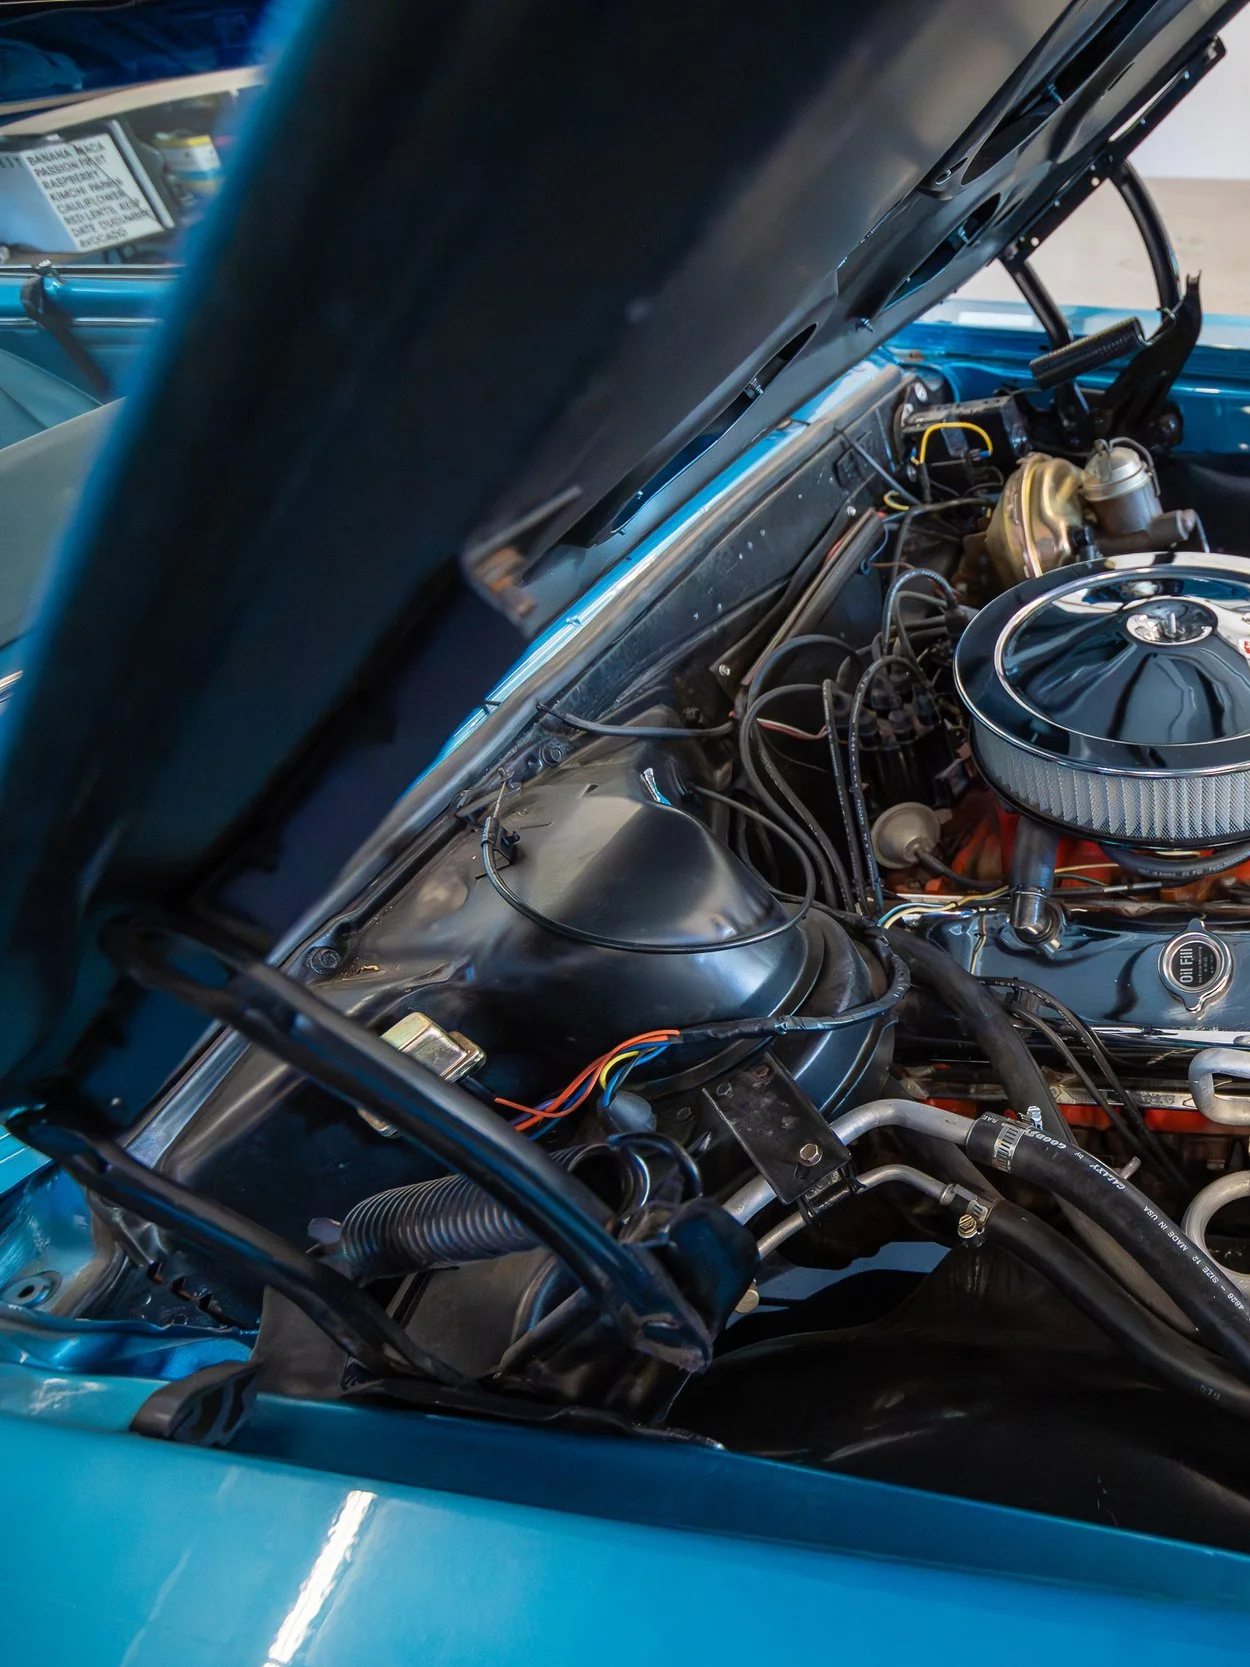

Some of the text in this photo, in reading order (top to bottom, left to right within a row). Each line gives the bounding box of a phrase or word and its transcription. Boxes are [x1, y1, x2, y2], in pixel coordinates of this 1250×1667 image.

[1180, 948, 1193, 984] Oil Fill
[1088, 1163, 1126, 1190] GALAXY
[1143, 1205, 1159, 1222] USA
[1157, 1220, 1166, 1230] IN
[1166, 1229, 1189, 1252] MADE
[1191, 1254, 1202, 1265] 12
[1201, 1266, 1219, 1284] SIZE
